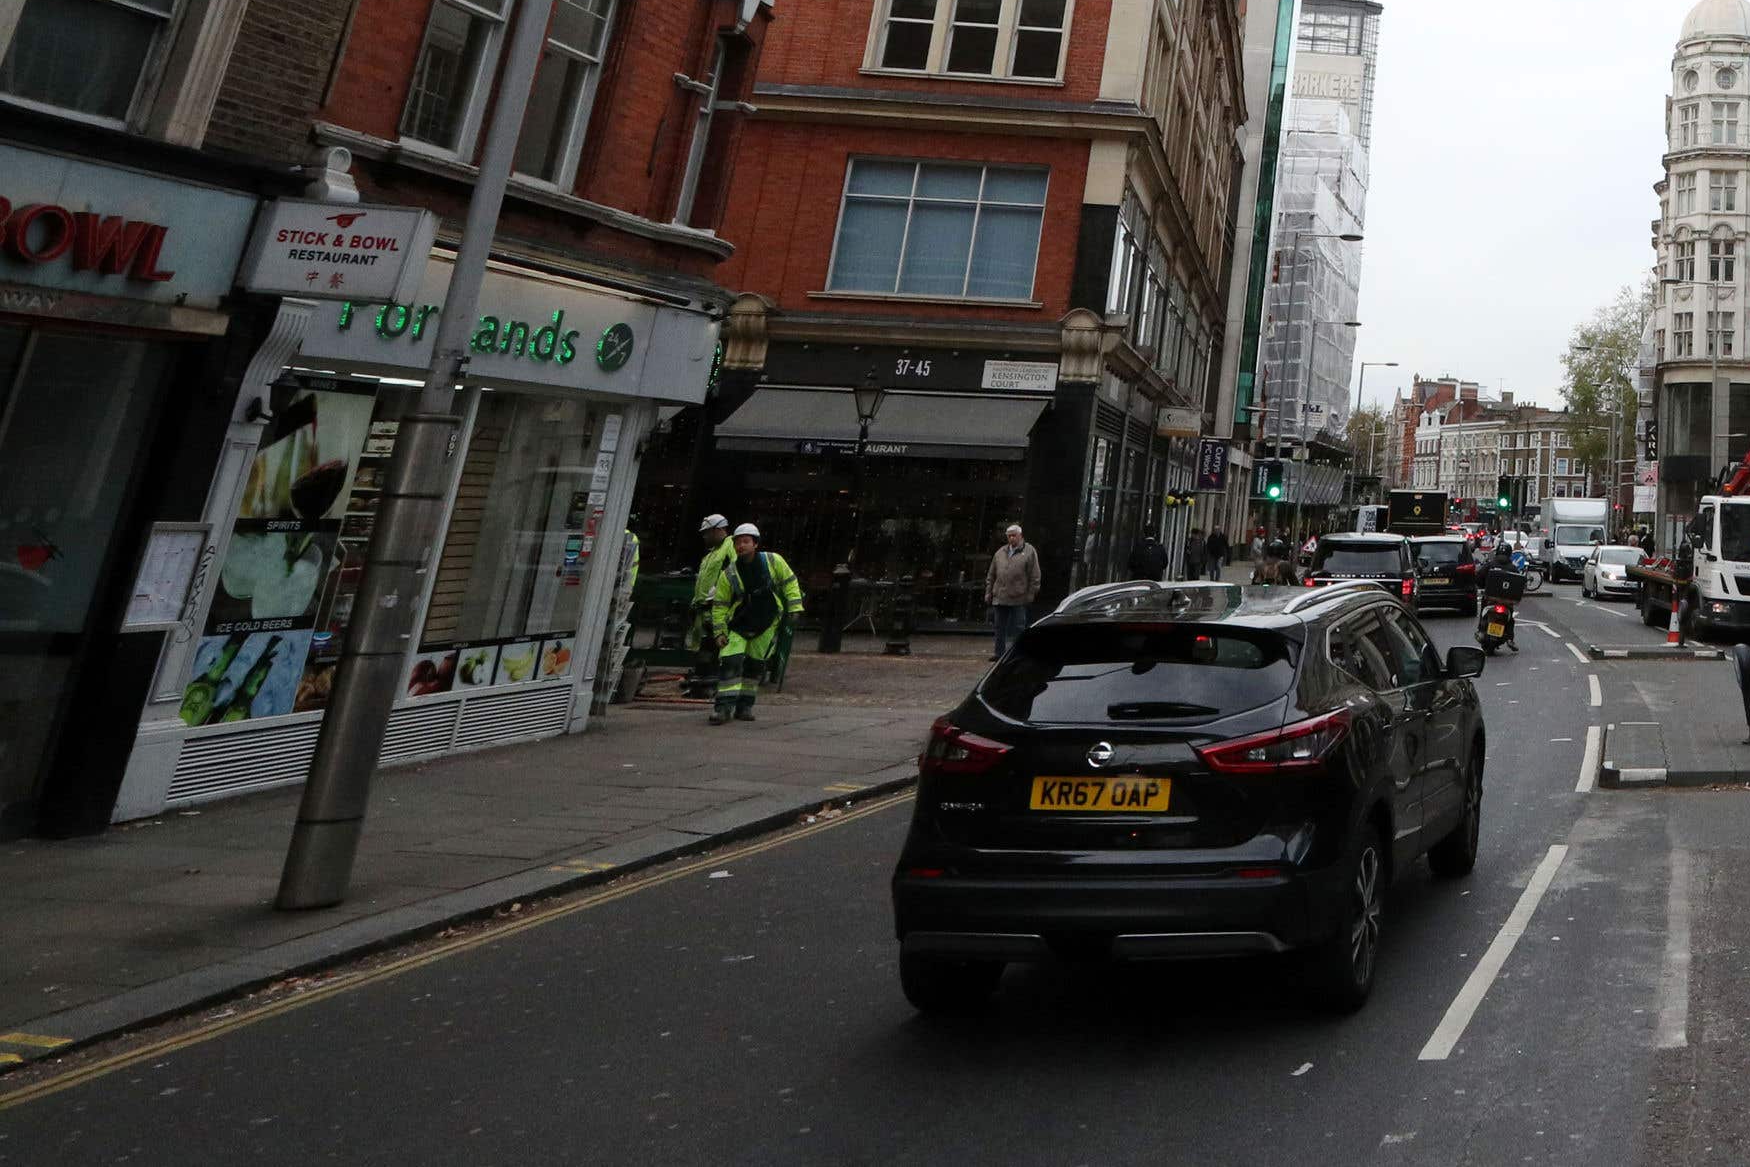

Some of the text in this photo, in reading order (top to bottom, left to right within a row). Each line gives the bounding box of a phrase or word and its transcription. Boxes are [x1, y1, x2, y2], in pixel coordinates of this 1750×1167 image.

[0, 196, 176, 281] OWL
[276, 228, 399, 251] STICK & BOWL
[288, 249, 379, 265] RESTAURANT
[895, 359, 931, 376] 37-45
[990, 380, 1020, 388] COURT
[991, 372, 1049, 381] KENSINGTON
[1213, 446, 1224, 473] Currys
[266, 521, 301, 530] SPIRITS
[216, 619, 293, 633] ICE COLD BEERS
[1041, 783, 1160, 807] KR67 OAP
